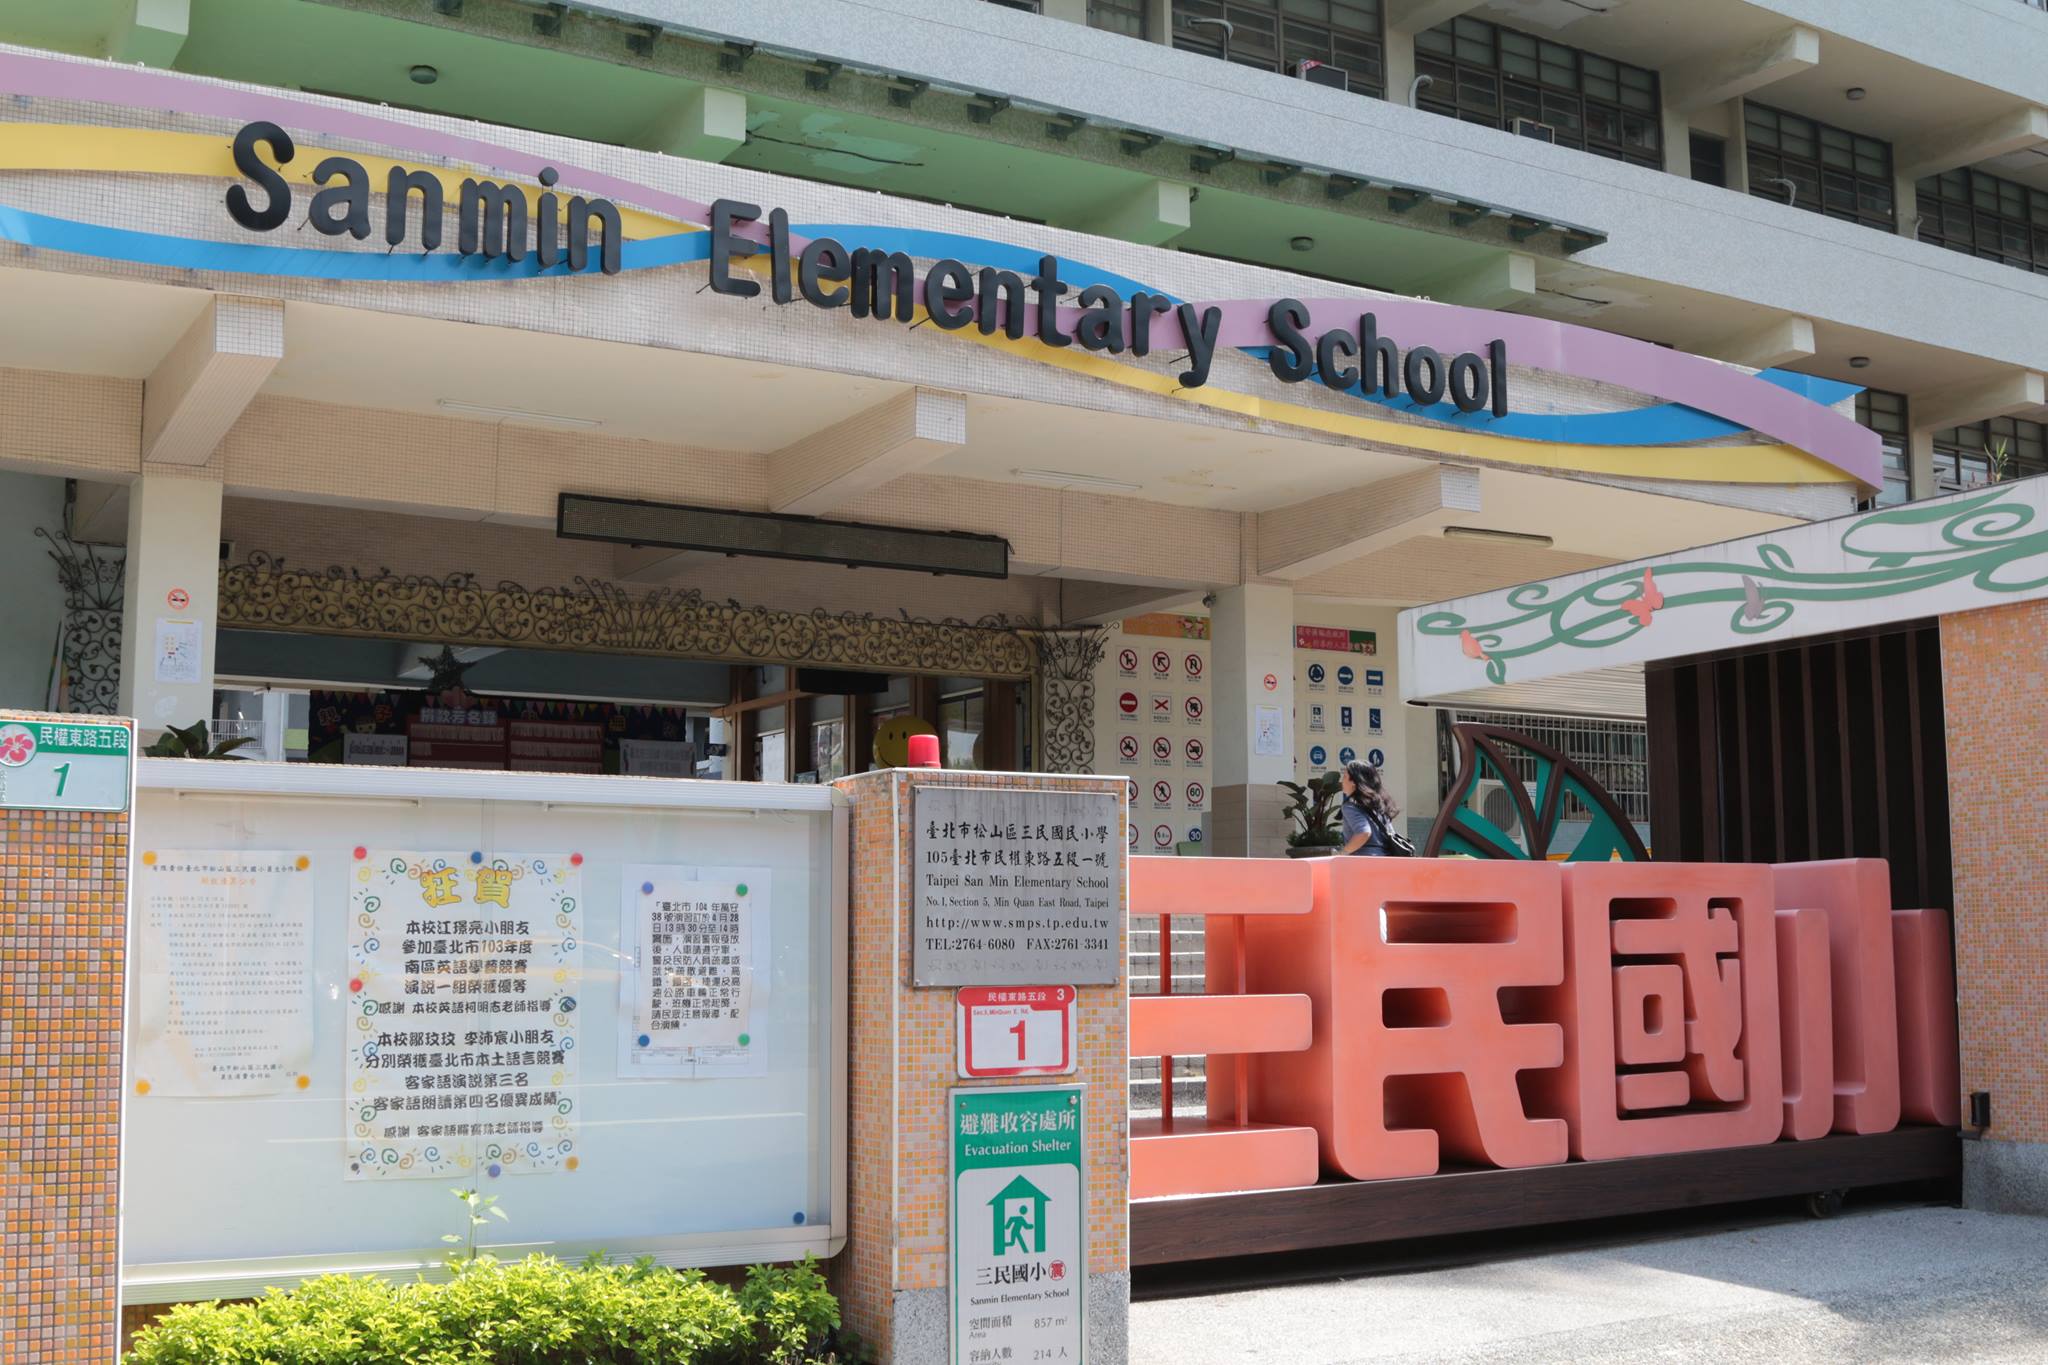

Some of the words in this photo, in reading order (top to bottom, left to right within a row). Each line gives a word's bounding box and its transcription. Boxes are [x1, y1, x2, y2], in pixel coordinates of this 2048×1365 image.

[226, 121, 621, 275] Sanmin
[709, 198, 1222, 388] Elementary
[1268, 298, 1508, 418] School
[39, 726, 128, 749] 民權東路五段
[54, 762, 71, 797] 1
[926, 821, 1109, 843] 臺北市松山區三民國民小學
[926, 849, 1109, 868] 105臺北市民權東路五段一號
[420, 866, 513, 908] 狂賀
[926, 874, 959, 889] Taipei
[964, 875, 983, 887] San
[989, 876, 1009, 888] Min
[1014, 876, 1071, 890] Elementary
[1077, 877, 1109, 889] School
[950, 897, 979, 907] Section
[983, 897, 990, 908] 5,
[994, 897, 1009, 907] Min
[1013, 897, 1035, 909] Quan
[1039, 898, 1055, 908] East
[1059, 898, 1082, 909] Road,
[1085, 899, 1109, 910] Taipei
[926, 916, 1109, 930] http://www.smps.tp.edu.tw
[401, 939, 533, 954] 參加臺北市103年度
[926, 938, 1015, 950] TEL:2764-6080
[1027, 938, 1109, 950] FAX:2761-3341
[404, 959, 528, 975] 南區英語學藝競賽
[404, 979, 527, 995] 演說一組榮獲優等
[988, 992, 1047, 1002] 民權東路五段
[1057, 989, 1065, 1000] 3
[378, 1001, 405, 1014] 感謝
[1130, 855, 1957, 1200] 三民國小
[1010, 1020, 1026, 1061] 1
[365, 1050, 565, 1069] 分別榮獲臺北市本土語言競賽
[404, 1072, 529, 1090] 客家語演說第三名
[373, 1091, 559, 1112] 客家語朗讀第四名優異成績
[960, 1109, 1076, 1135] 避難收容處所
[384, 1126, 410, 1138] 感謝
[965, 1142, 1028, 1157] Evacuation
[1032, 1139, 1071, 1153] Shelter
[976, 1262, 1047, 1286] 三民國小
[970, 1296, 999, 1306] Sanmin
[1000, 1292, 1042, 1303] Elementary
[1044, 1288, 1070, 1299] School
[969, 1315, 1012, 1330] 空間面積
[1034, 1317, 1052, 1328] 857
[969, 1331, 987, 1340] Area
[969, 1347, 1012, 1362] 容納人數
[1034, 1349, 1052, 1361] 214
[1058, 1346, 1068, 1358] 人
